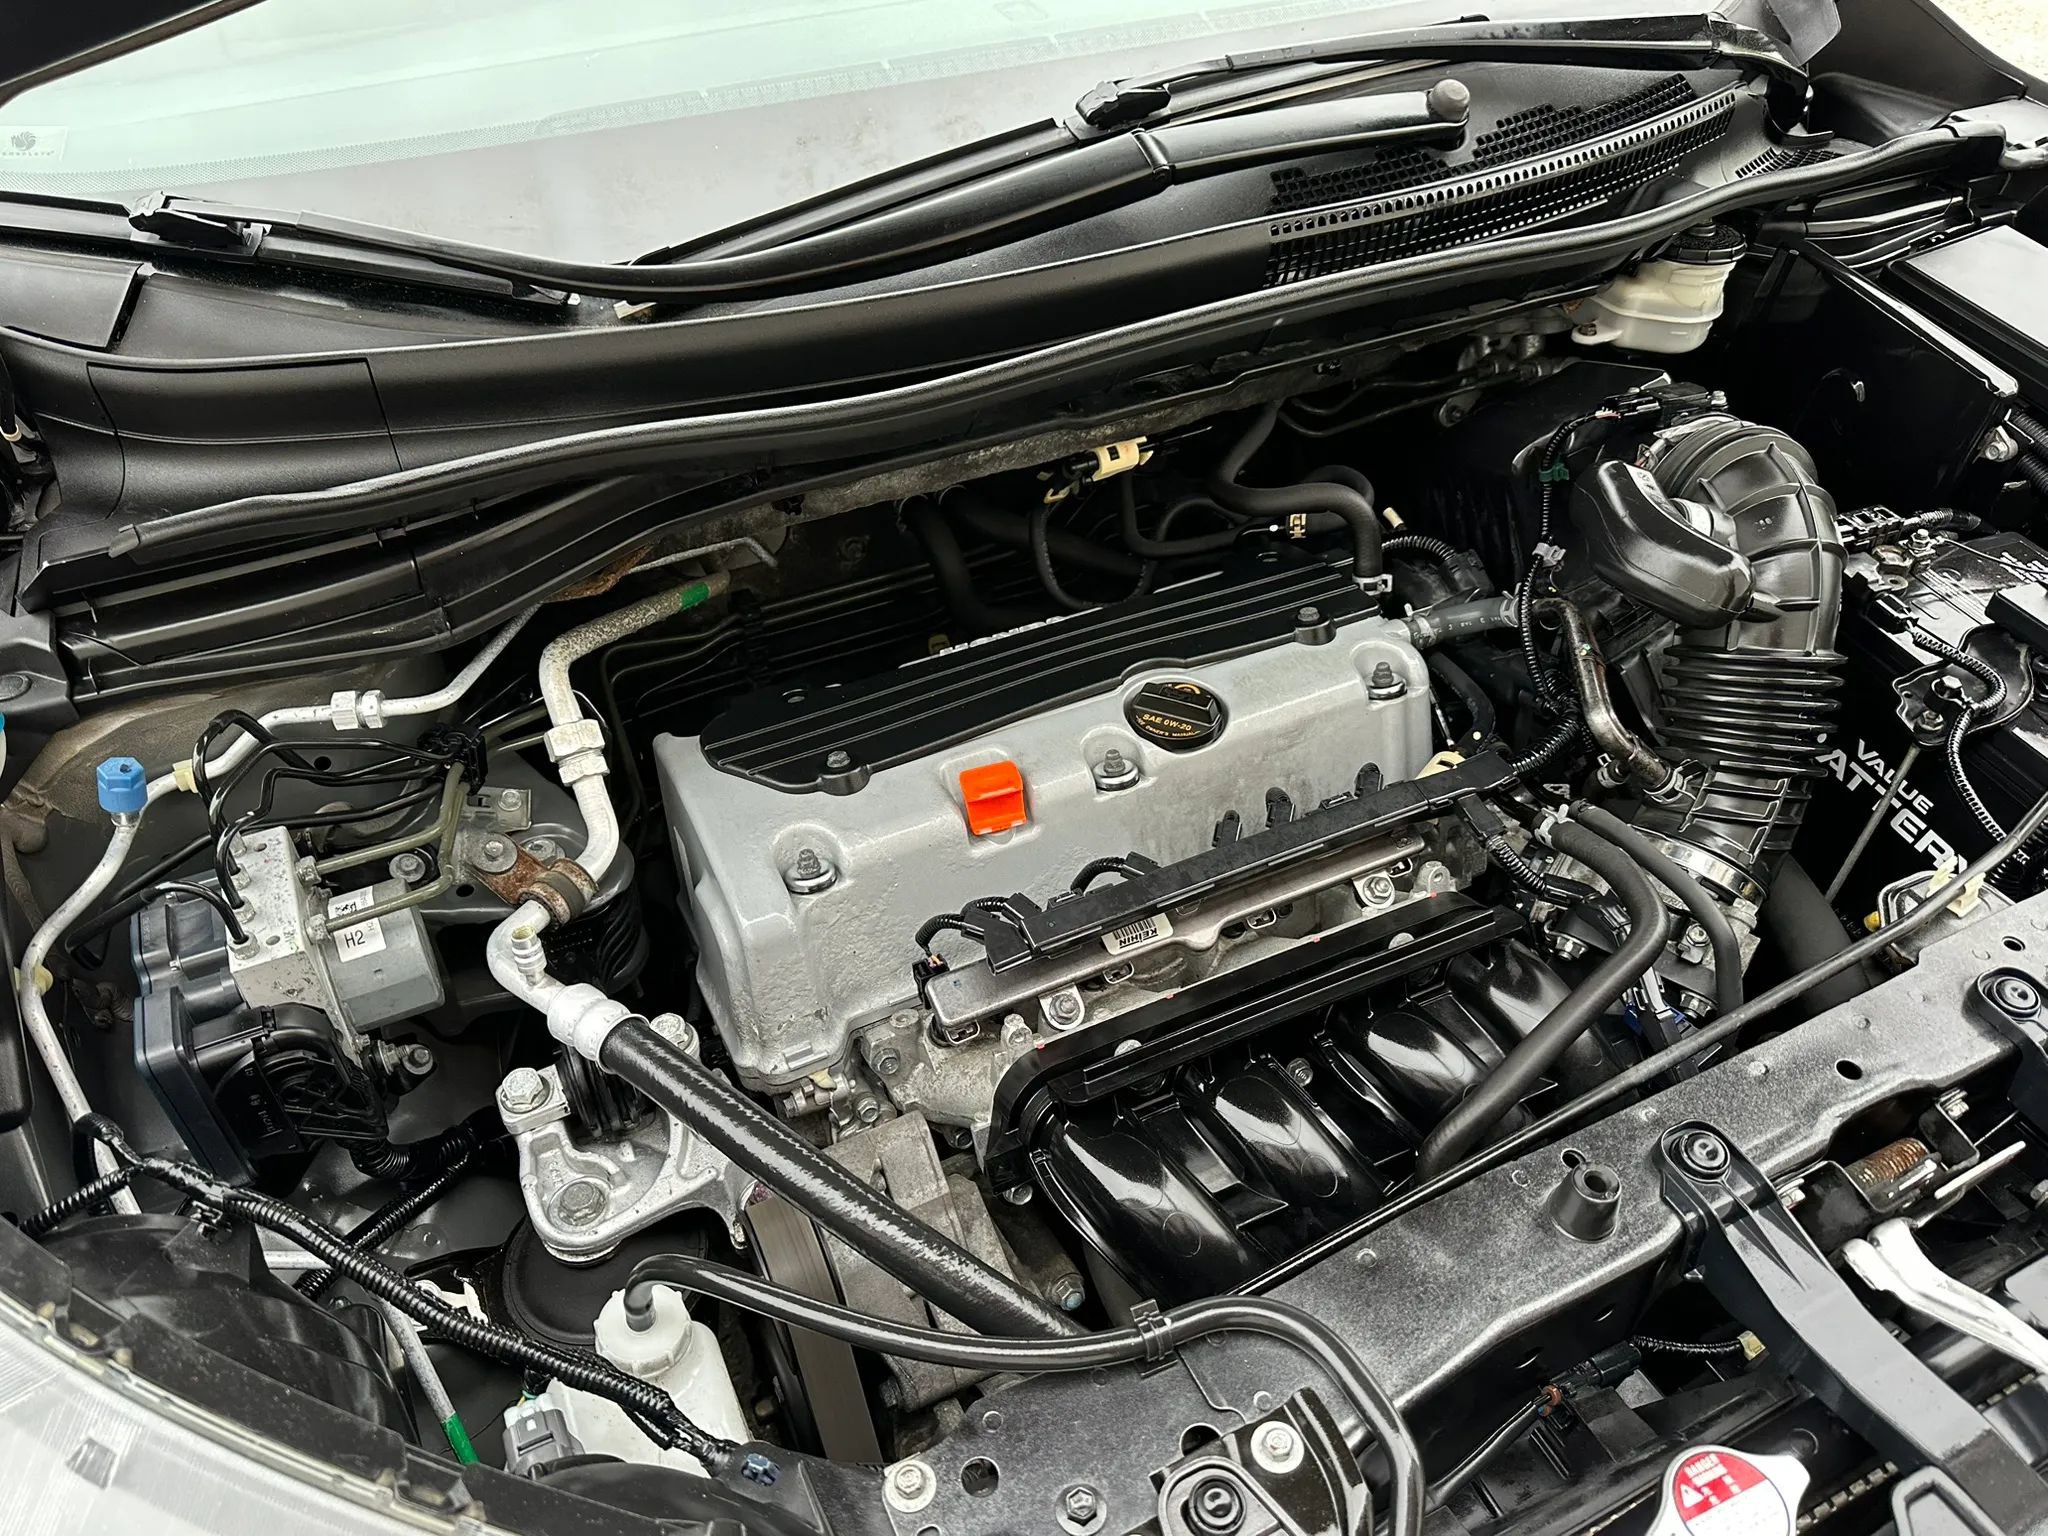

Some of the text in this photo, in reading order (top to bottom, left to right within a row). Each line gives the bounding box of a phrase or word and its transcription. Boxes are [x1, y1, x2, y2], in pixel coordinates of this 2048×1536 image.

[1142, 713, 1192, 731] SAE 0W-20
[1857, 738, 1934, 815] VALUE
[1815, 748, 1968, 874] ATTER
[344, 929, 366, 949] H2
[1119, 927, 1158, 947] KEIHIN
